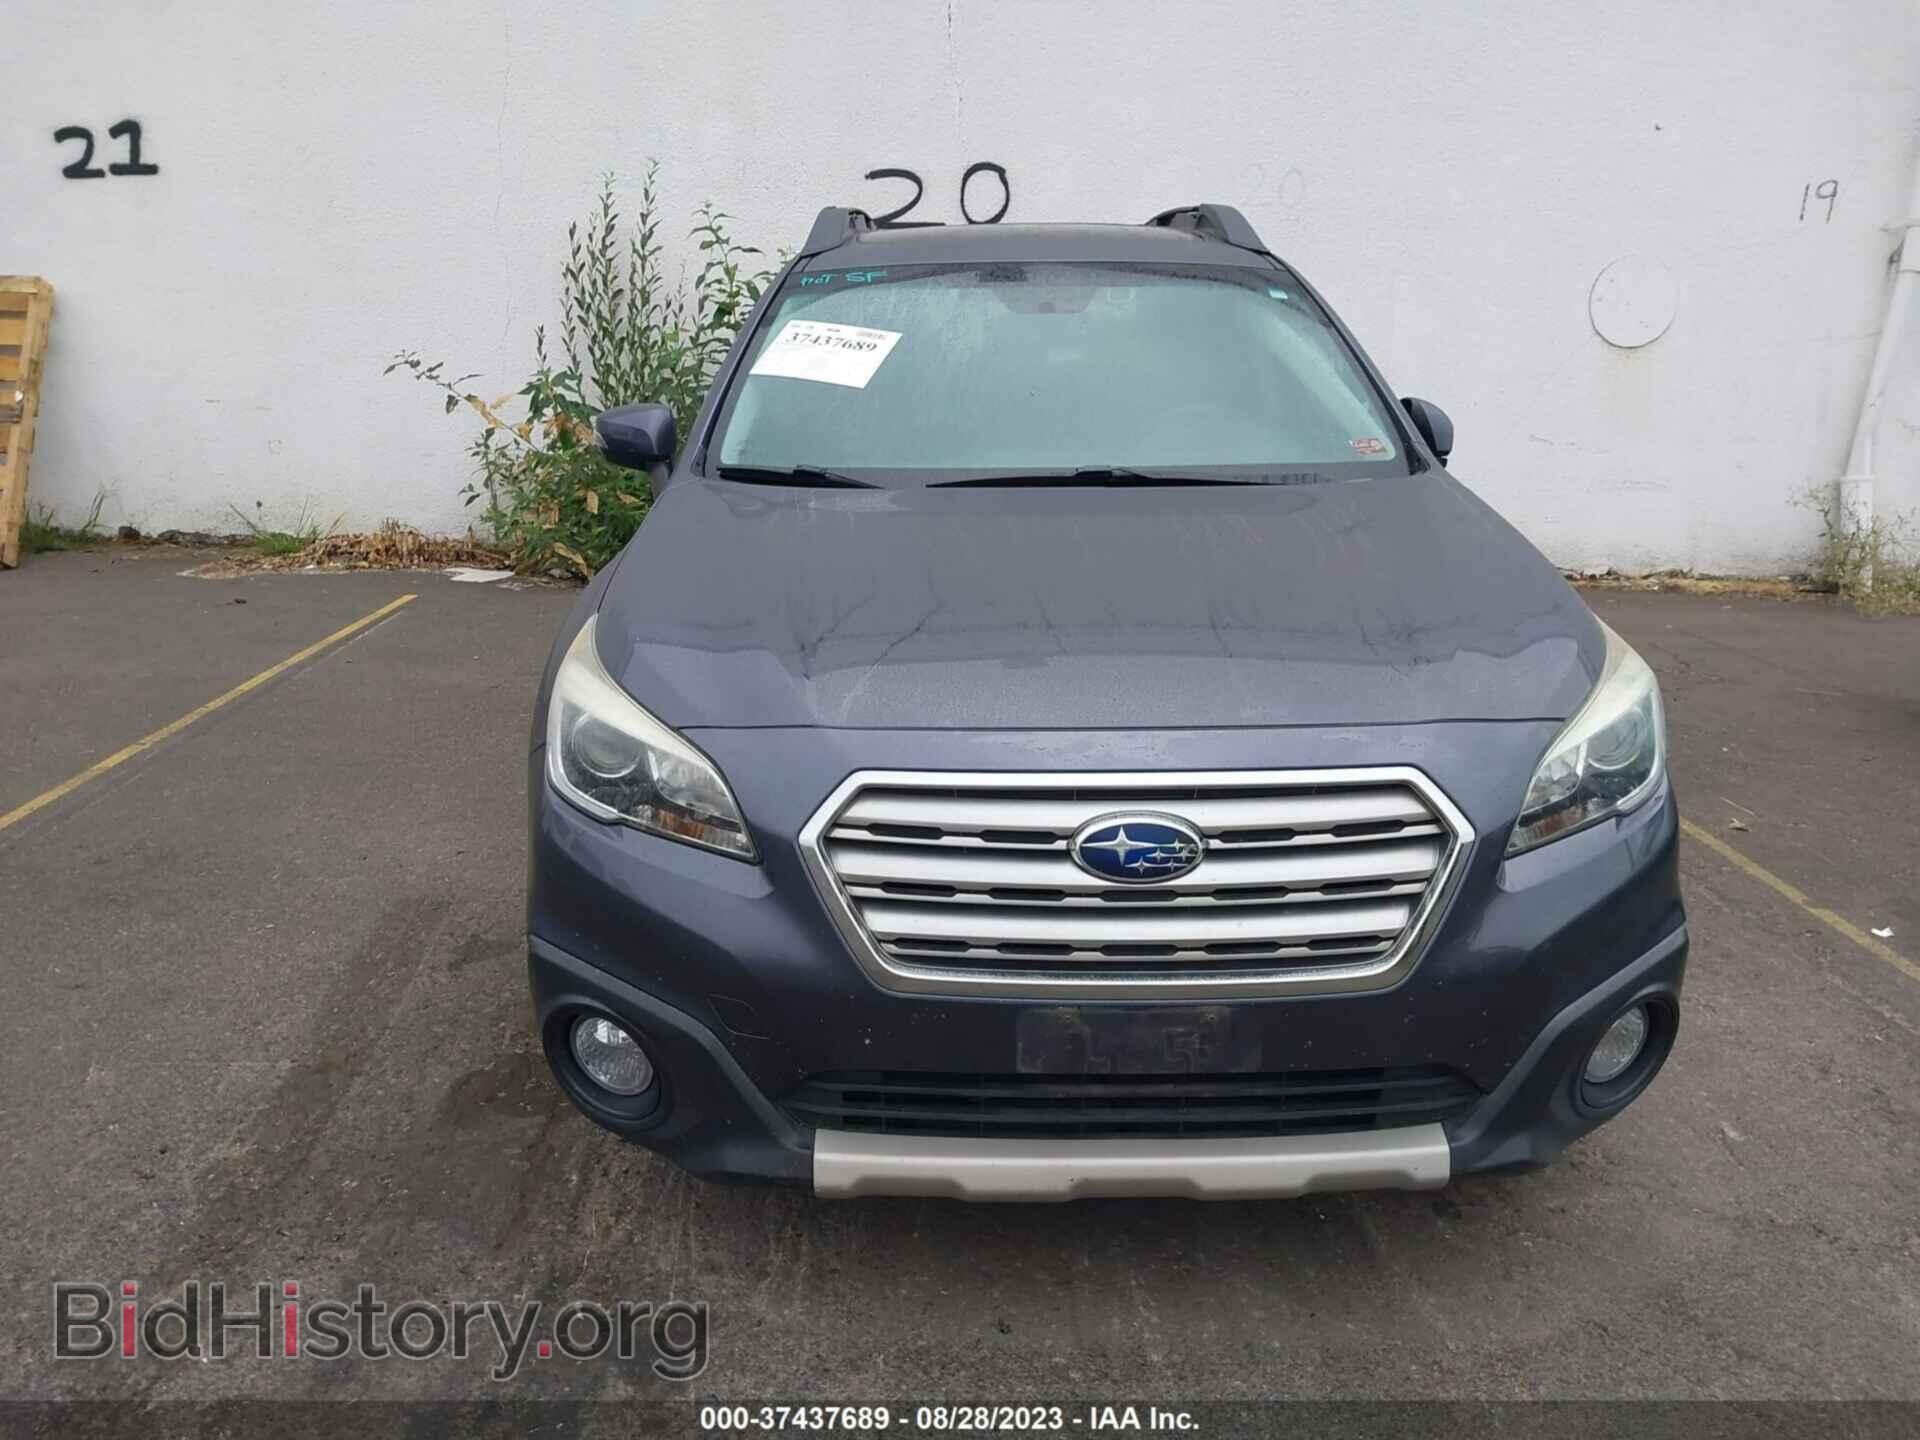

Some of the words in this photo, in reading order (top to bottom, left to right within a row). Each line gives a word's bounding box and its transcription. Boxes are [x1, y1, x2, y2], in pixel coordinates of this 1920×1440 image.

[53, 119, 158, 179] 21
[865, 162, 1009, 227] 20
[1800, 179, 1838, 224] 19
[785, 332, 878, 352] 37437689
